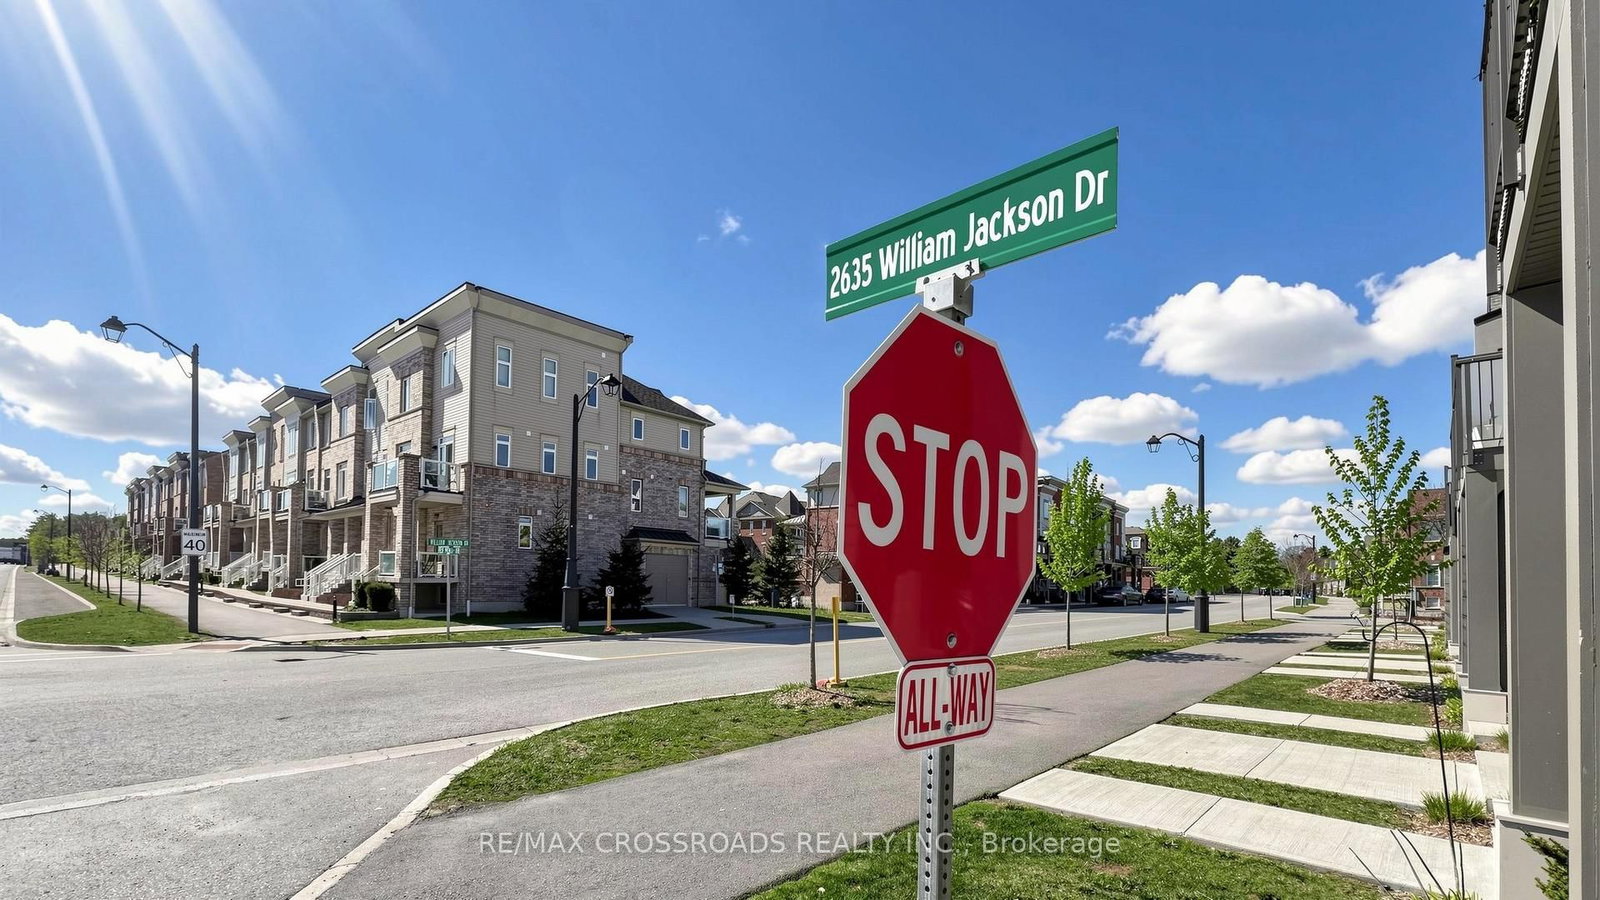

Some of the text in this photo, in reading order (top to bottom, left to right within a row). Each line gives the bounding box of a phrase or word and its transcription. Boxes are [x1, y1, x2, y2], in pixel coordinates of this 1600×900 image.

[829, 169, 1109, 299] 2635 William Jackson Dr
[857, 413, 1028, 558] STOP
[184, 539, 206, 551] 40
[904, 672, 990, 736] ALL-WAY
